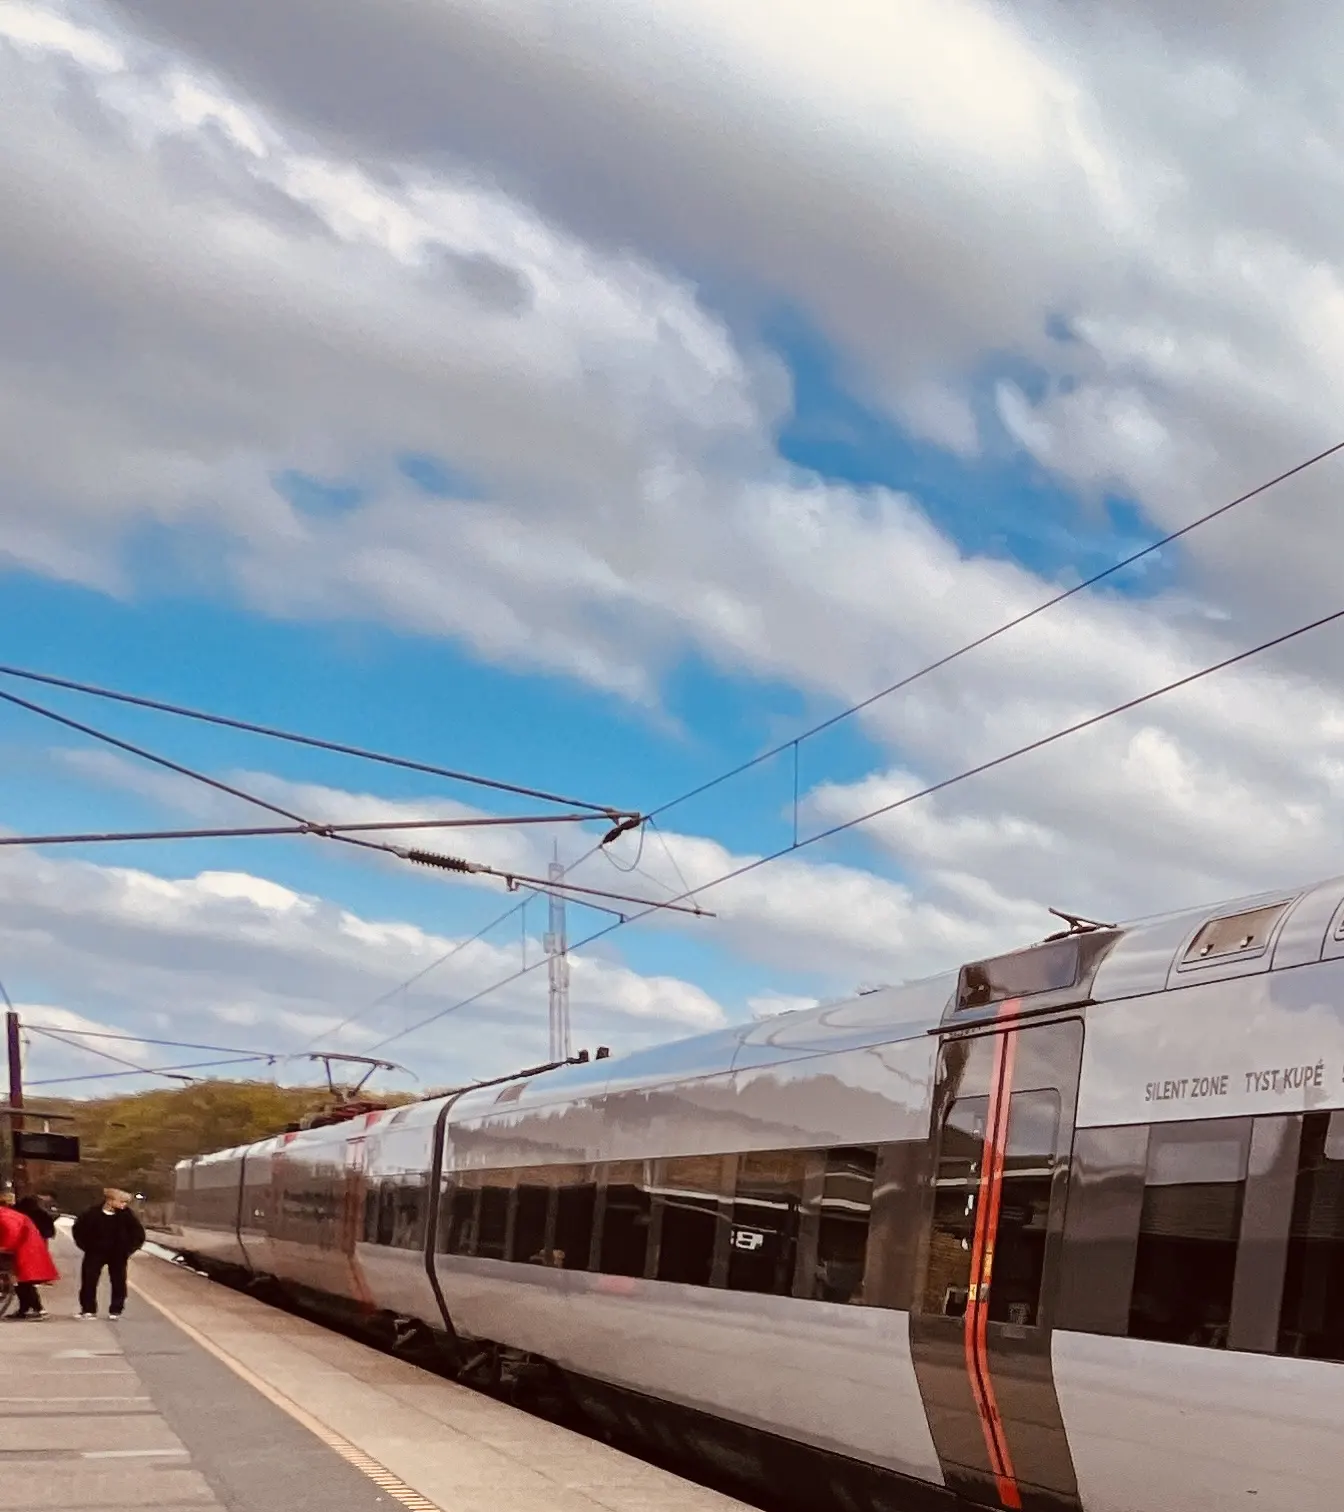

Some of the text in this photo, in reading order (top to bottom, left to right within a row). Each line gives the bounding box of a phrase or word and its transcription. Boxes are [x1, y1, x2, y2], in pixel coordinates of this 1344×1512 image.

[1145, 1079, 1189, 1101] SILENT
[1191, 1075, 1229, 1098] ZONE
[1245, 1069, 1280, 1093] TYST
[1283, 1059, 1324, 1089] KUPÉ
